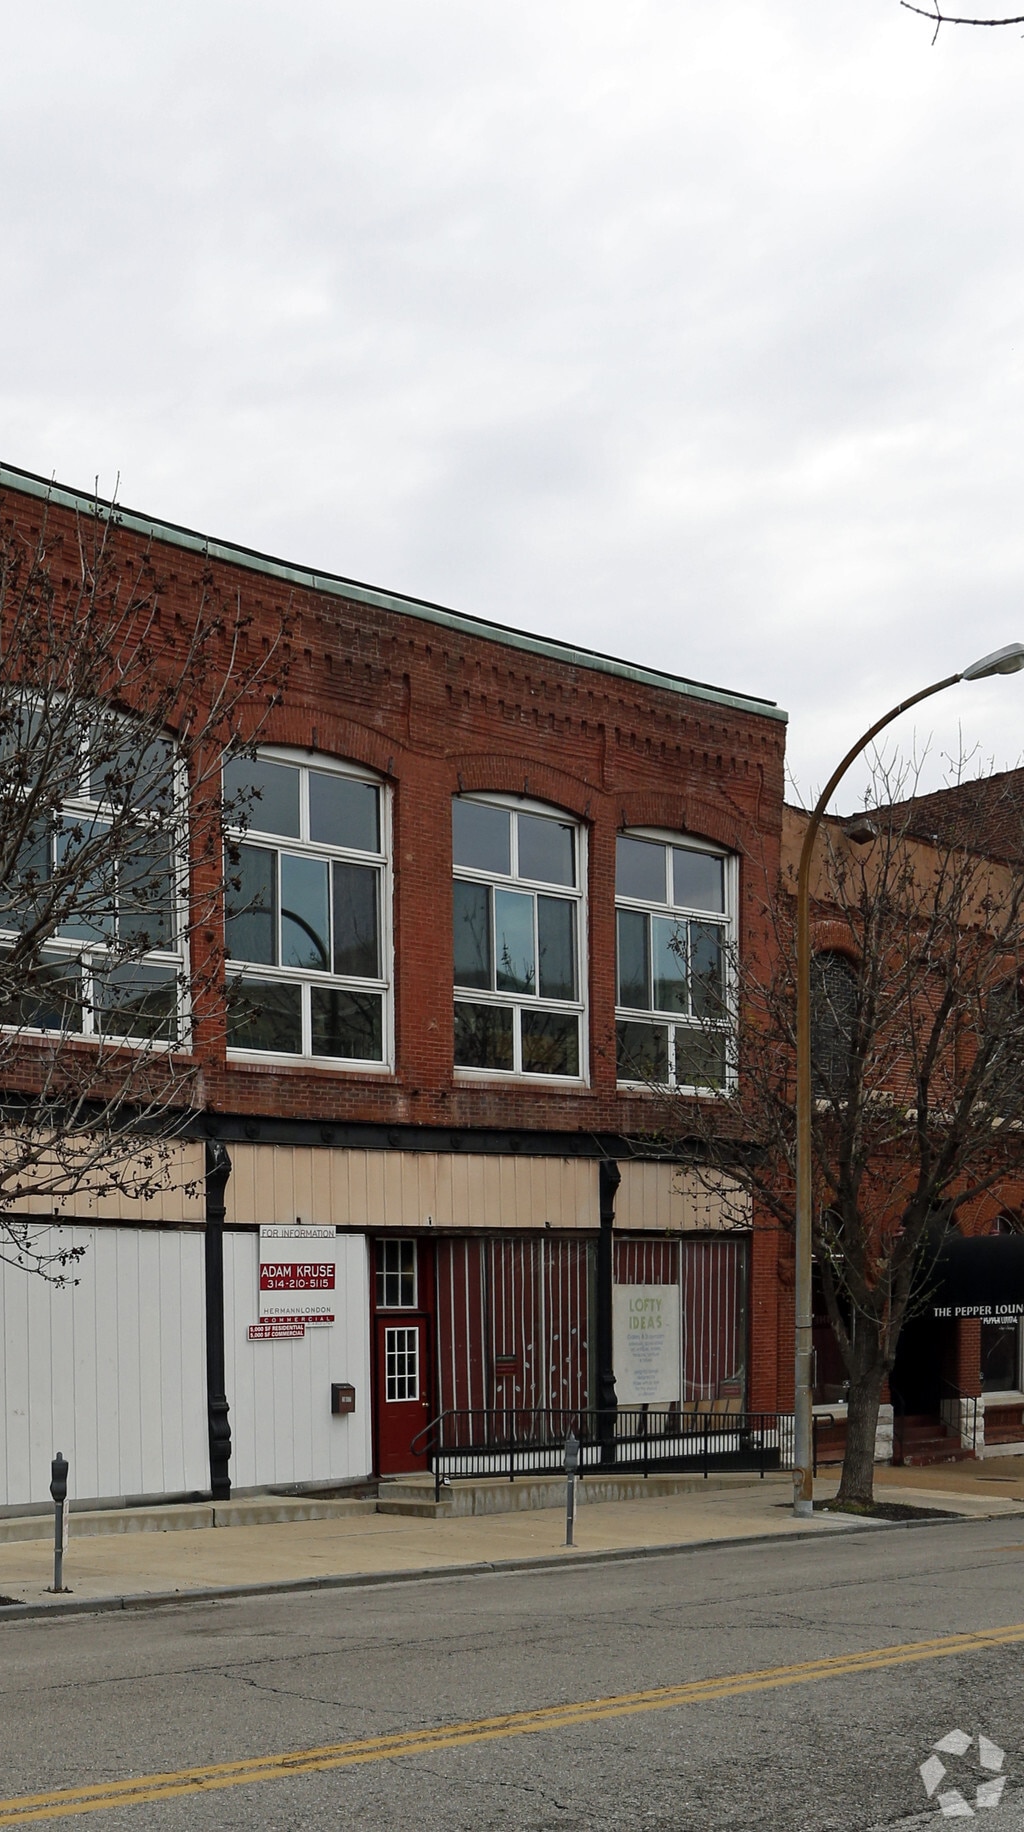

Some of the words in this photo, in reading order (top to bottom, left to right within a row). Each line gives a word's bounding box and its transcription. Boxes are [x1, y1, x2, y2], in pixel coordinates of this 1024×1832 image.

[261, 1229, 279, 1237] FOR
[281, 1229, 335, 1238] INFORMATION
[261, 1265, 292, 1277] ADAM
[296, 1265, 334, 1277] KRUSE
[267, 1279, 329, 1288] 314-210-5115
[629, 1298, 662, 1312] LOFTY
[933, 1307, 952, 1317] THE
[954, 1305, 992, 1317] PEPPER
[629, 1315, 662, 1329] IDEAS
